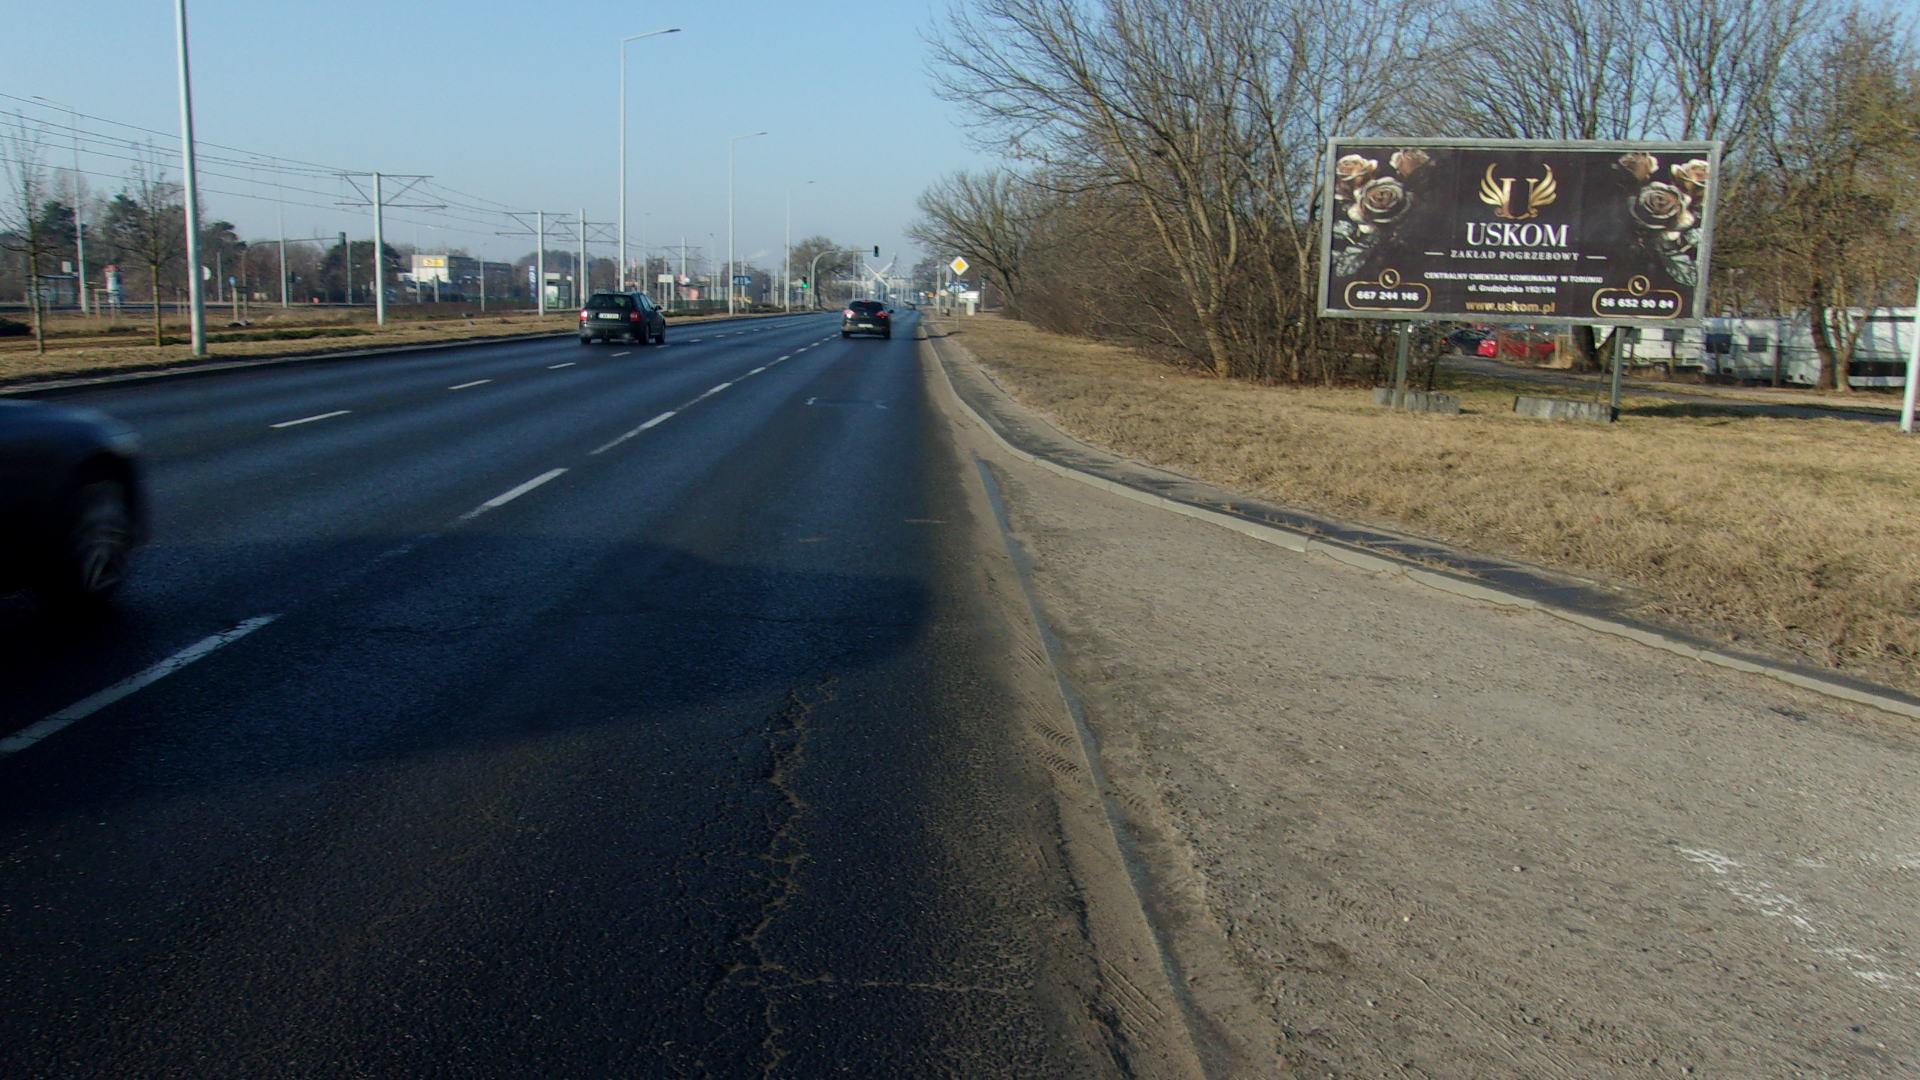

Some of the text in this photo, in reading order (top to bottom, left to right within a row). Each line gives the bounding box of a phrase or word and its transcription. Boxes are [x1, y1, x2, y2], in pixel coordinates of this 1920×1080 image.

[1466, 222, 1570, 247] USKOM
[1450, 249, 1581, 261] ZAKŁAD POGRZEBOWY
[1424, 272, 1468, 280] CENTRALNY
[1468, 273, 1508, 281] CMENTARZ
[1509, 274, 1558, 282] KOMUNALNY
[1465, 300, 1556, 314] www.uskom.pl
